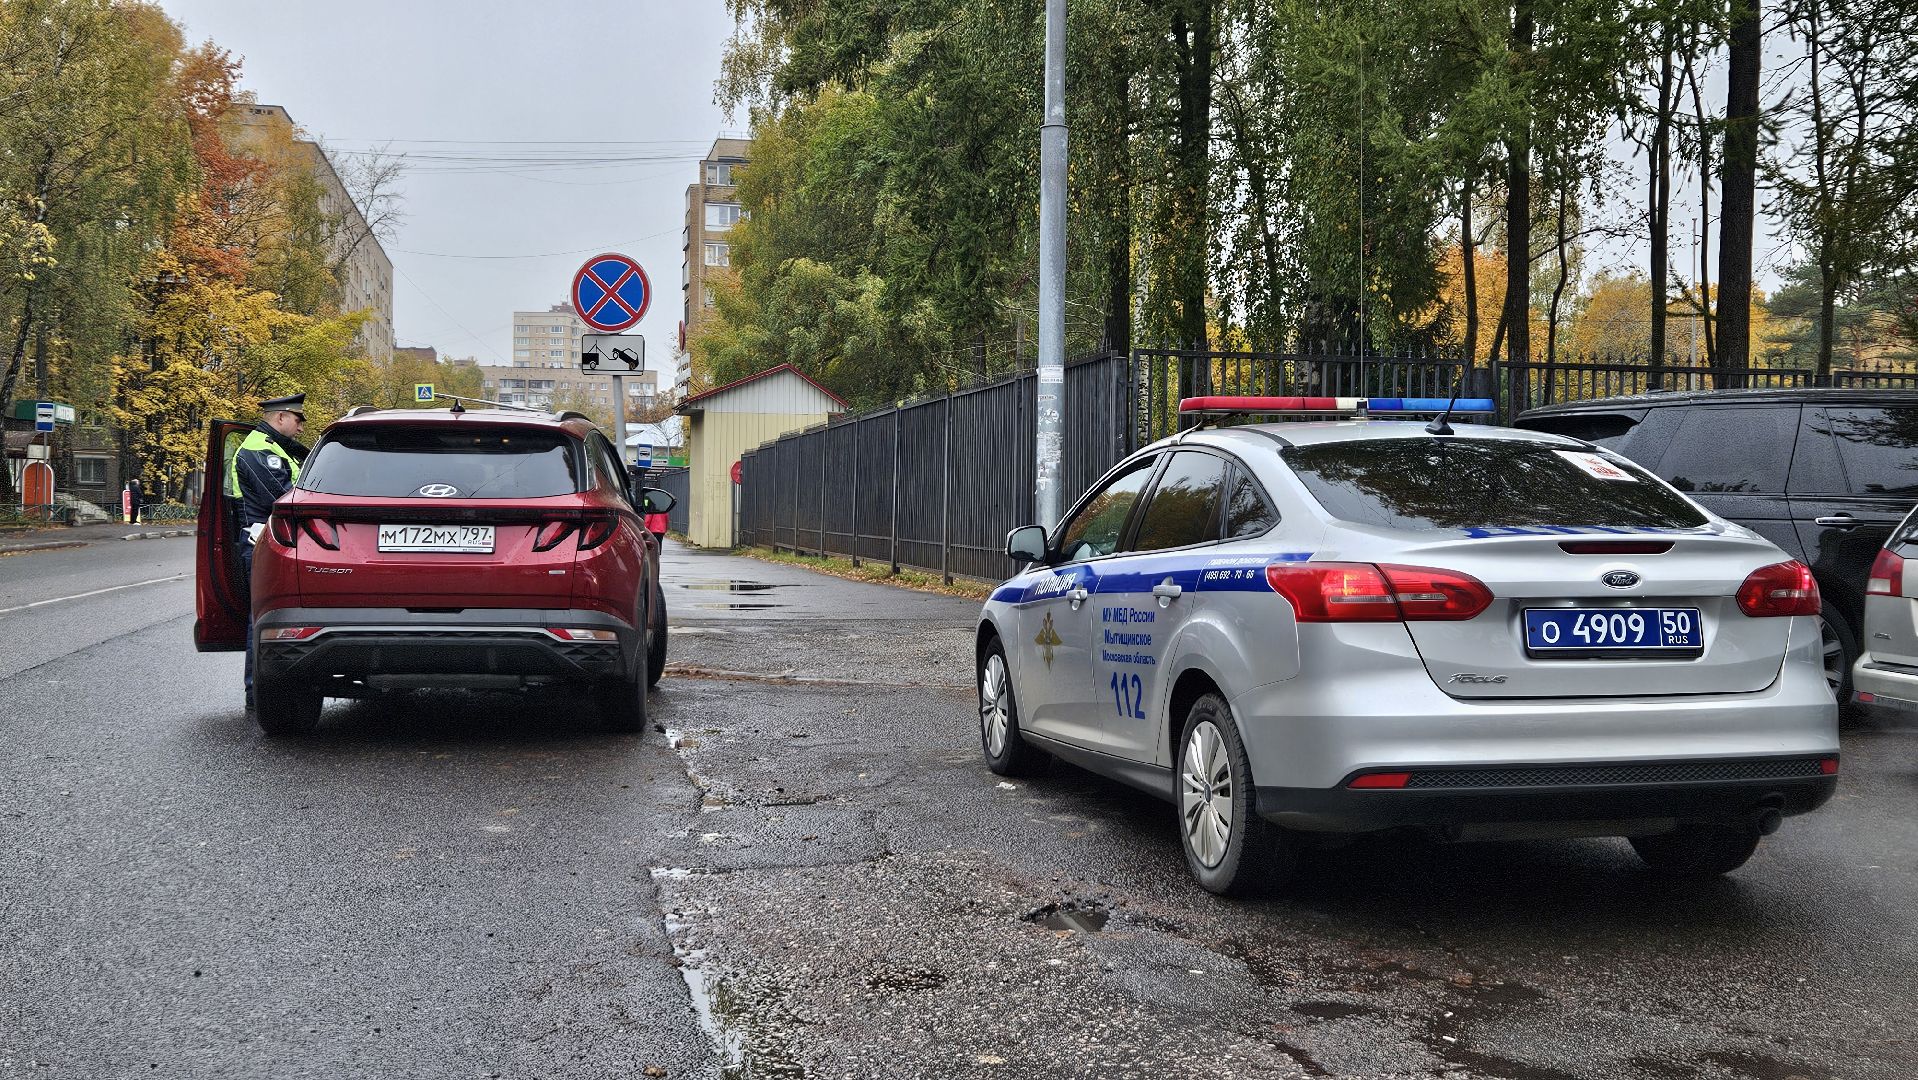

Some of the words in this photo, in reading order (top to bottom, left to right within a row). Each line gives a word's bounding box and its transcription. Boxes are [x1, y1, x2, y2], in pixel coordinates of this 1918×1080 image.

[384, 526, 458, 544] М172МХ
[461, 527, 490, 541] 797
[1035, 572, 1077, 595] ПОЛИЦИЯ
[1612, 574, 1633, 585] Ford
[1103, 607, 1112, 622] МУ
[1129, 607, 1155, 623] России
[1573, 613, 1645, 643] 4909
[1662, 611, 1691, 634] 50
[1104, 628, 1152, 647] Мытищинское
[1668, 635, 1689, 644] RUS
[1102, 649, 1133, 663] Московская
[1133, 651, 1156, 665] область
[1110, 671, 1146, 720] 112
